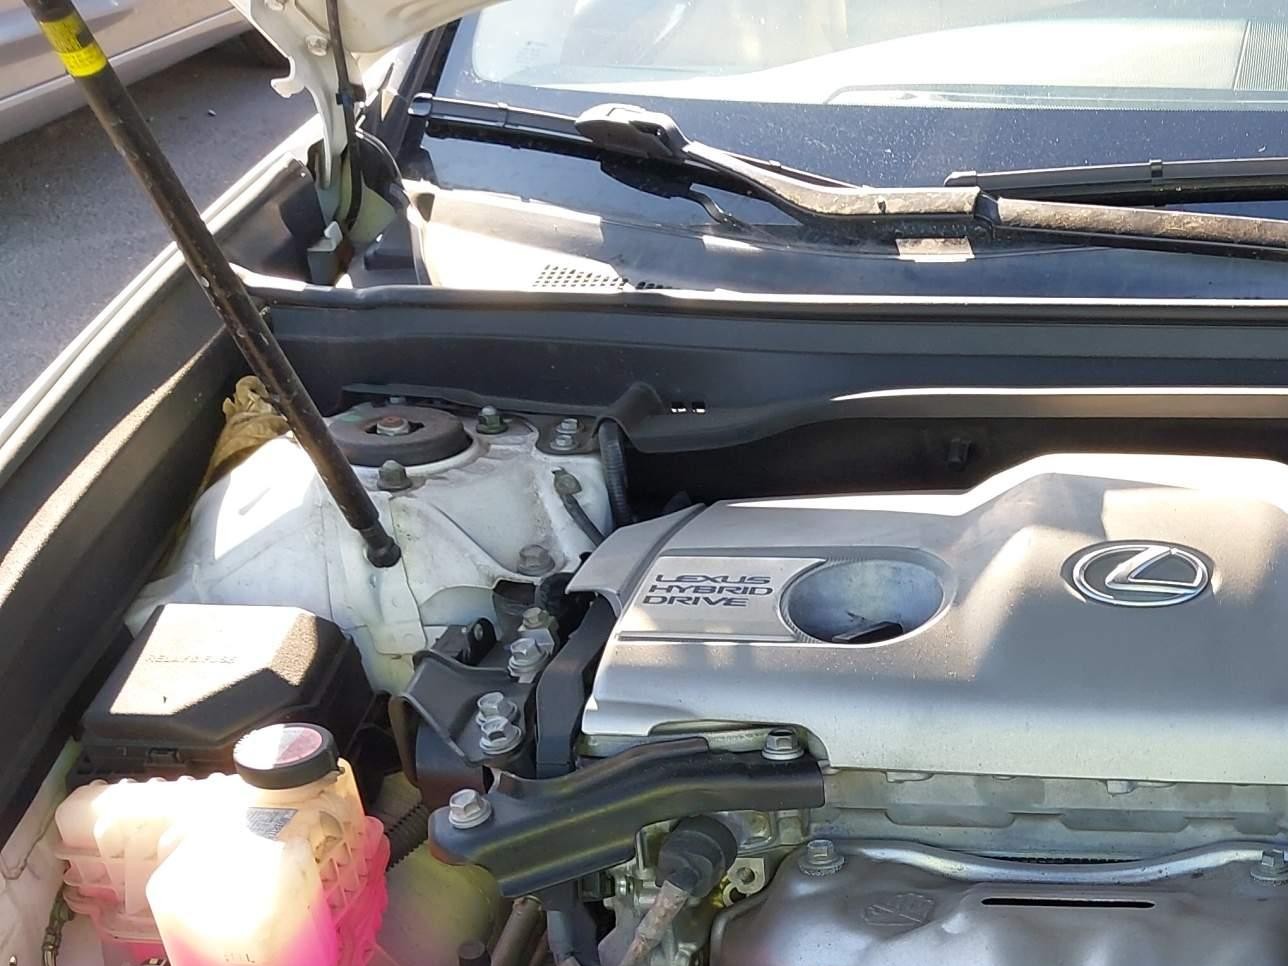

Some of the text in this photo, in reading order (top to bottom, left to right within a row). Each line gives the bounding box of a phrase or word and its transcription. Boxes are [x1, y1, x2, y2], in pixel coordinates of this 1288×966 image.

[655, 574, 771, 585] LEXUS
[649, 585, 773, 596] HYBRID
[642, 595, 749, 607] DRIVE
